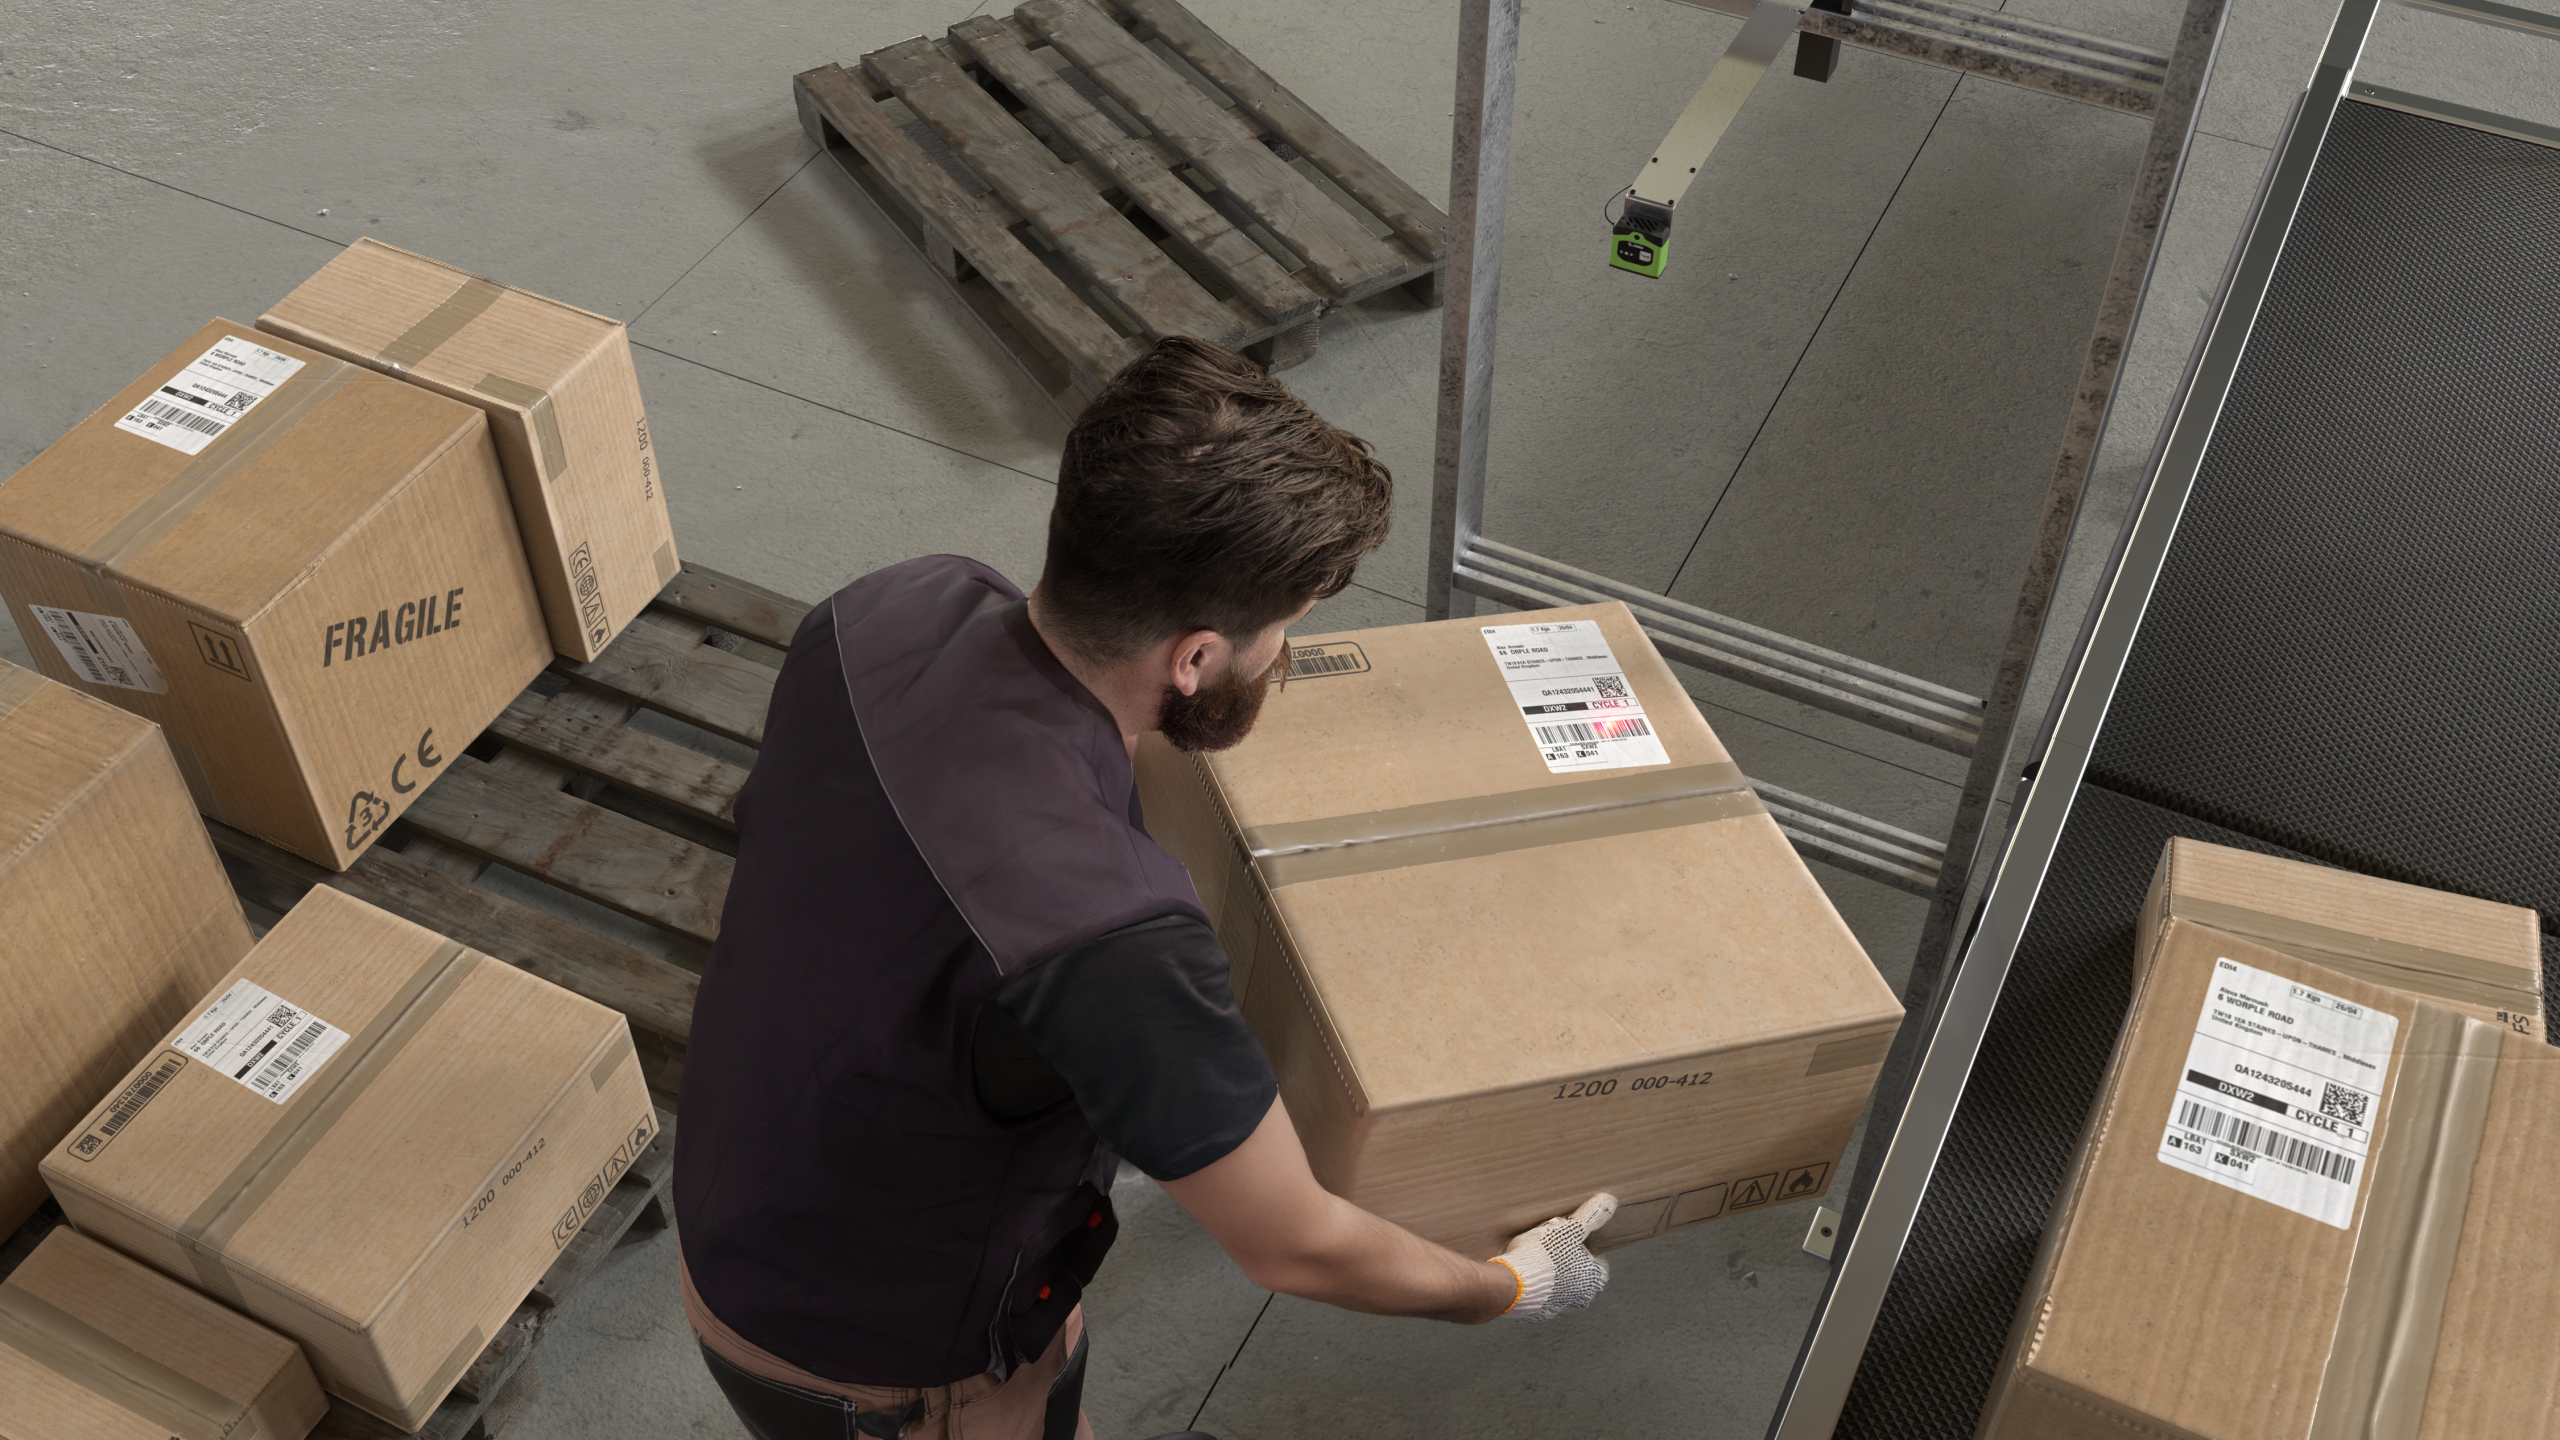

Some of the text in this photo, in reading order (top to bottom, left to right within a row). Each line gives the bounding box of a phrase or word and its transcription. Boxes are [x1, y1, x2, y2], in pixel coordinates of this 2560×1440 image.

[637, 417, 653, 501] 1200 000-412
[324, 587, 464, 668] FRAGILE
[1293, 648, 1325, 659] 00007
[2219, 961, 2237, 972] EDI4
[2292, 988, 2321, 1003] 1.7 Kgs
[2217, 992, 2294, 1025] 6 WORPLE ROAD
[2335, 1002, 2357, 1015] 26/04
[2211, 1014, 2262, 1037] United Kingdom
[2213, 1009, 2231, 1019] TW18
[2247, 1020, 2276, 1035] STAINES
[2282, 1033, 2302, 1044] UPON
[110, 1071, 153, 1113] 0000781340
[1553, 1072, 1713, 1099] 1200 000-412
[2217, 1081, 2255, 1102] DXW2
[2234, 1063, 2312, 1098] QA1243205444
[2182, 1141, 2202, 1155] 163
[2183, 1131, 2206, 1146] LBA1
[2229, 1158, 2249, 1171] 041
[462, 1137, 546, 1229] 1200 000-412
